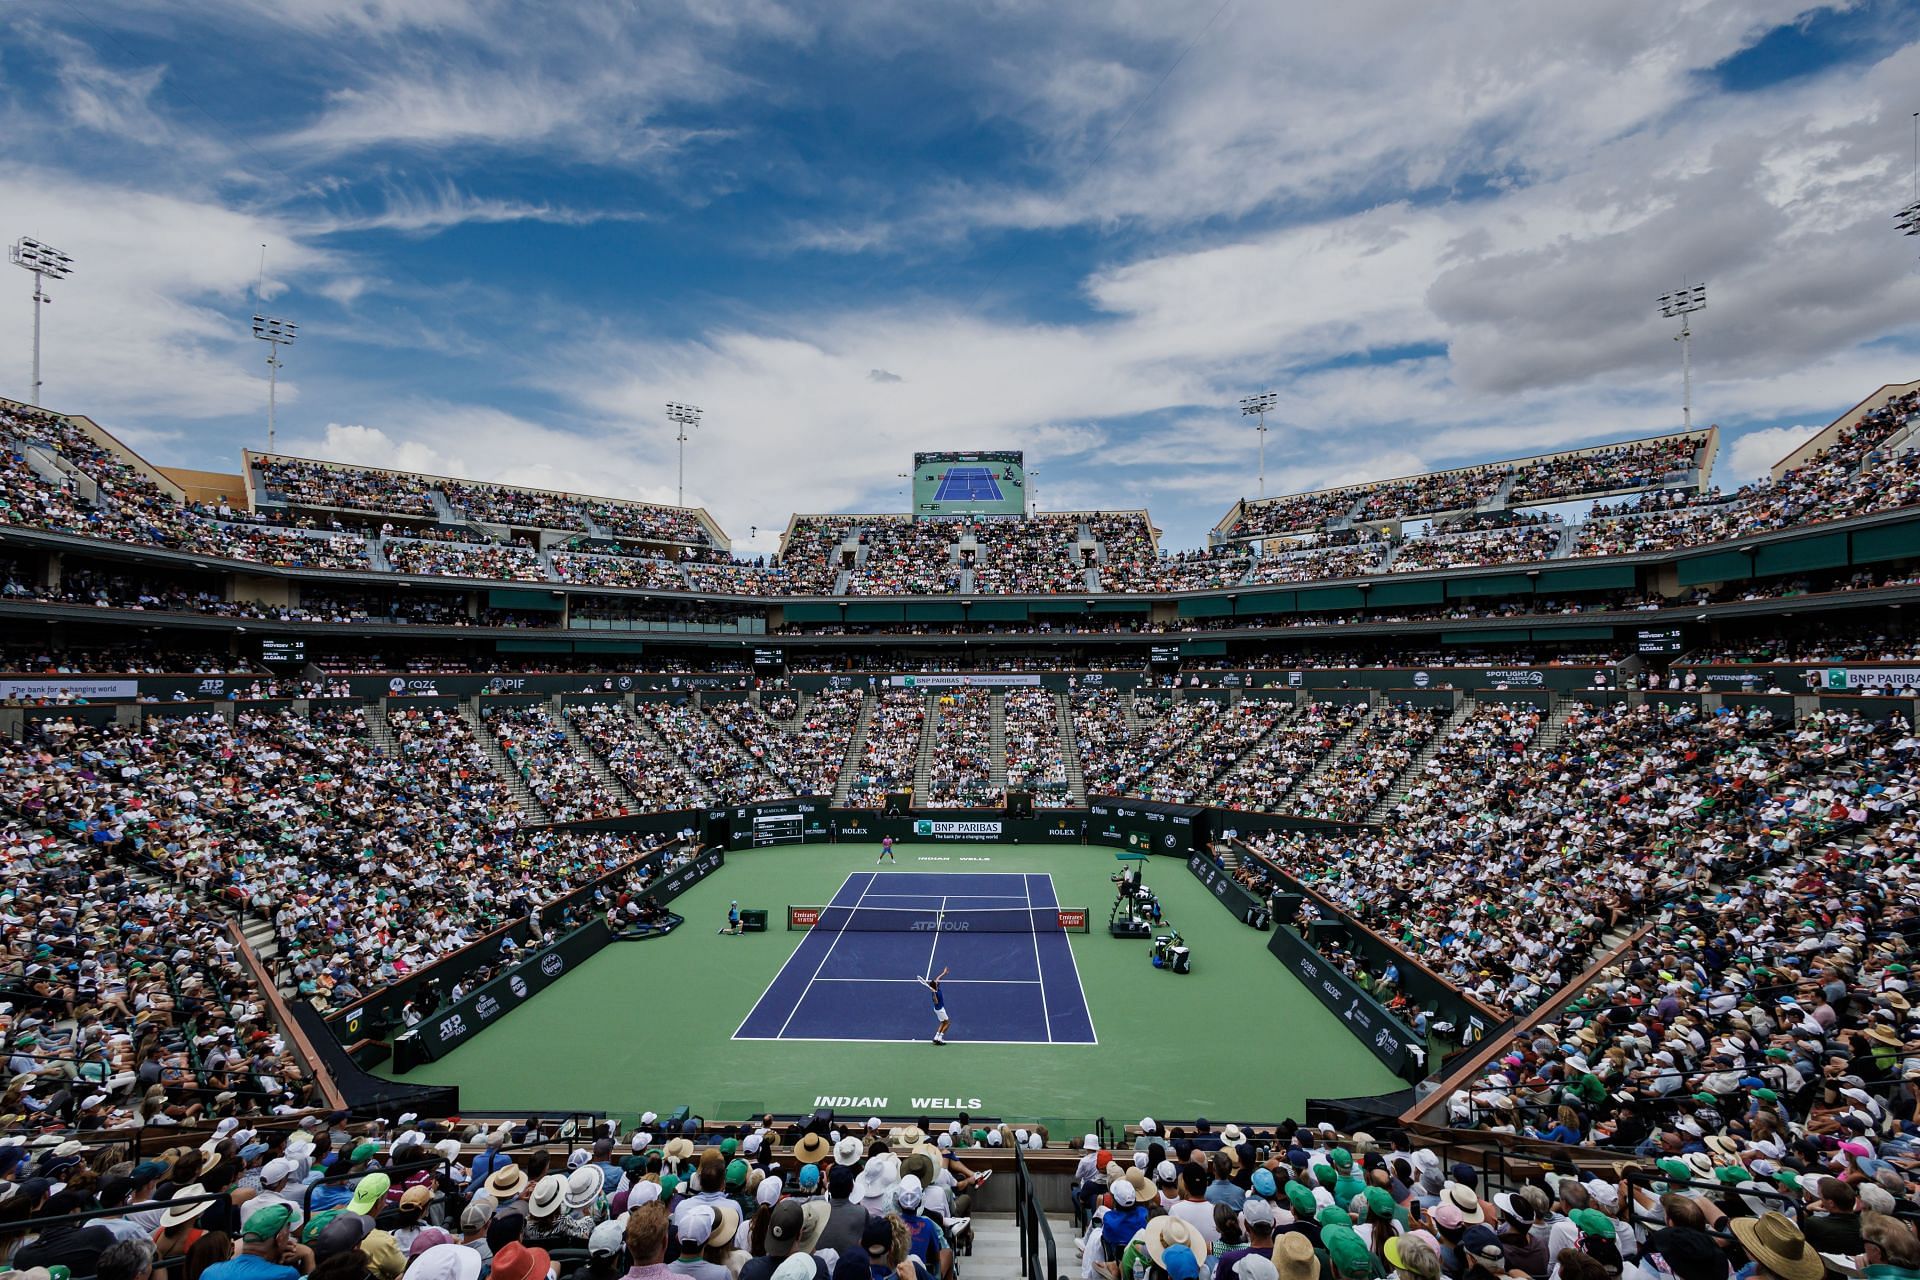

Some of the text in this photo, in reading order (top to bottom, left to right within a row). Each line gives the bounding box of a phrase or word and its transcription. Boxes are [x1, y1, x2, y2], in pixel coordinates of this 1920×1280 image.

[506, 679, 525, 689] PIF
[1850, 674, 1874, 683] BNP
[199, 679, 224, 690] ATP
[935, 823, 998, 832] BNP PARIBAS
[910, 921, 969, 931] ATP TOUR
[439, 1014, 462, 1038] ATP
[455, 1024, 467, 1036] 1000
[1387, 1034, 1399, 1049] WTA
[813, 1096, 982, 1109] INDIAN WELLS
